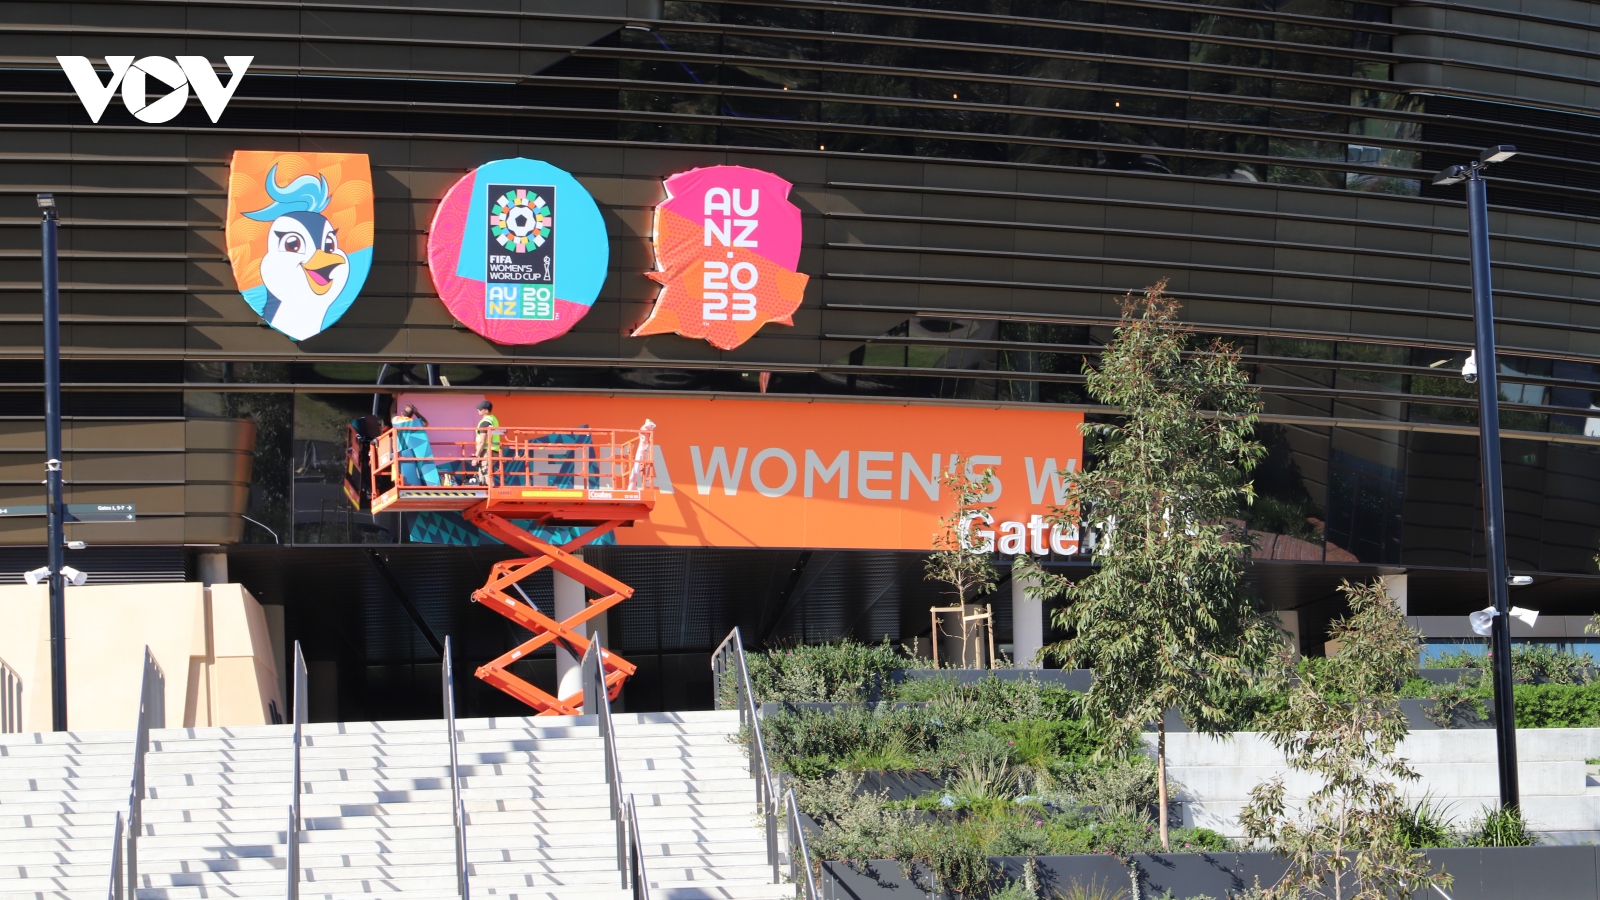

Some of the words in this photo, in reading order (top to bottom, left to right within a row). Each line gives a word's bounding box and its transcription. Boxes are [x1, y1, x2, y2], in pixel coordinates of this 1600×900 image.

[704, 187, 759, 217] AU
[704, 218, 759, 248] NZ
[489, 255, 512, 264] FIFA
[489, 264, 533, 273] WOMEN'S
[489, 272, 522, 280] WORLD
[522, 272, 541, 281] CUP
[703, 261, 758, 291] 20
[489, 286, 517, 301] AU
[522, 287, 551, 302] 20
[489, 301, 517, 315] NZ
[522, 301, 550, 316] 23
[702, 292, 757, 321] 23
[690, 445, 1003, 505] WOMEN'S
[590, 491, 612, 499] Coates
[960, 510, 1080, 556] Gate
